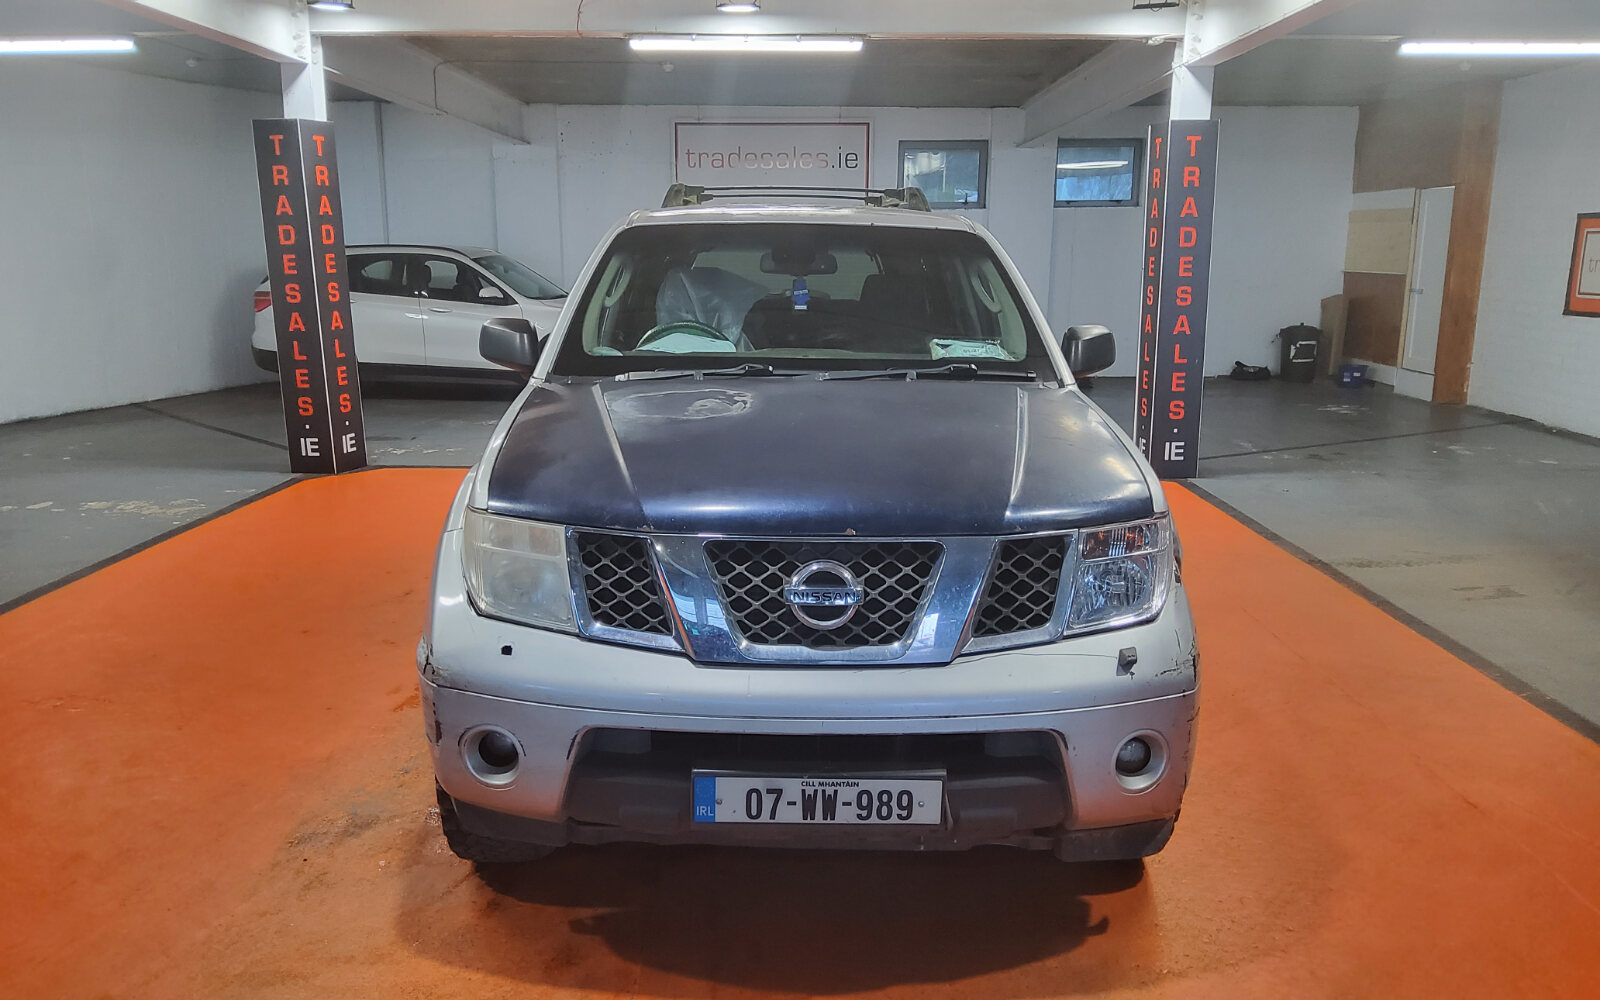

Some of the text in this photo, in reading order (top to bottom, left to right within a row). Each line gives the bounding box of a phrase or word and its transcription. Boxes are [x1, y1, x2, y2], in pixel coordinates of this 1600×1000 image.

[685, 145, 859, 169] tradesales.ie
[793, 591, 857, 602] NISSAN
[801, 780, 816, 788] CILL
[745, 788, 914, 821] 07-WW-989
[696, 805, 715, 817] IRL
